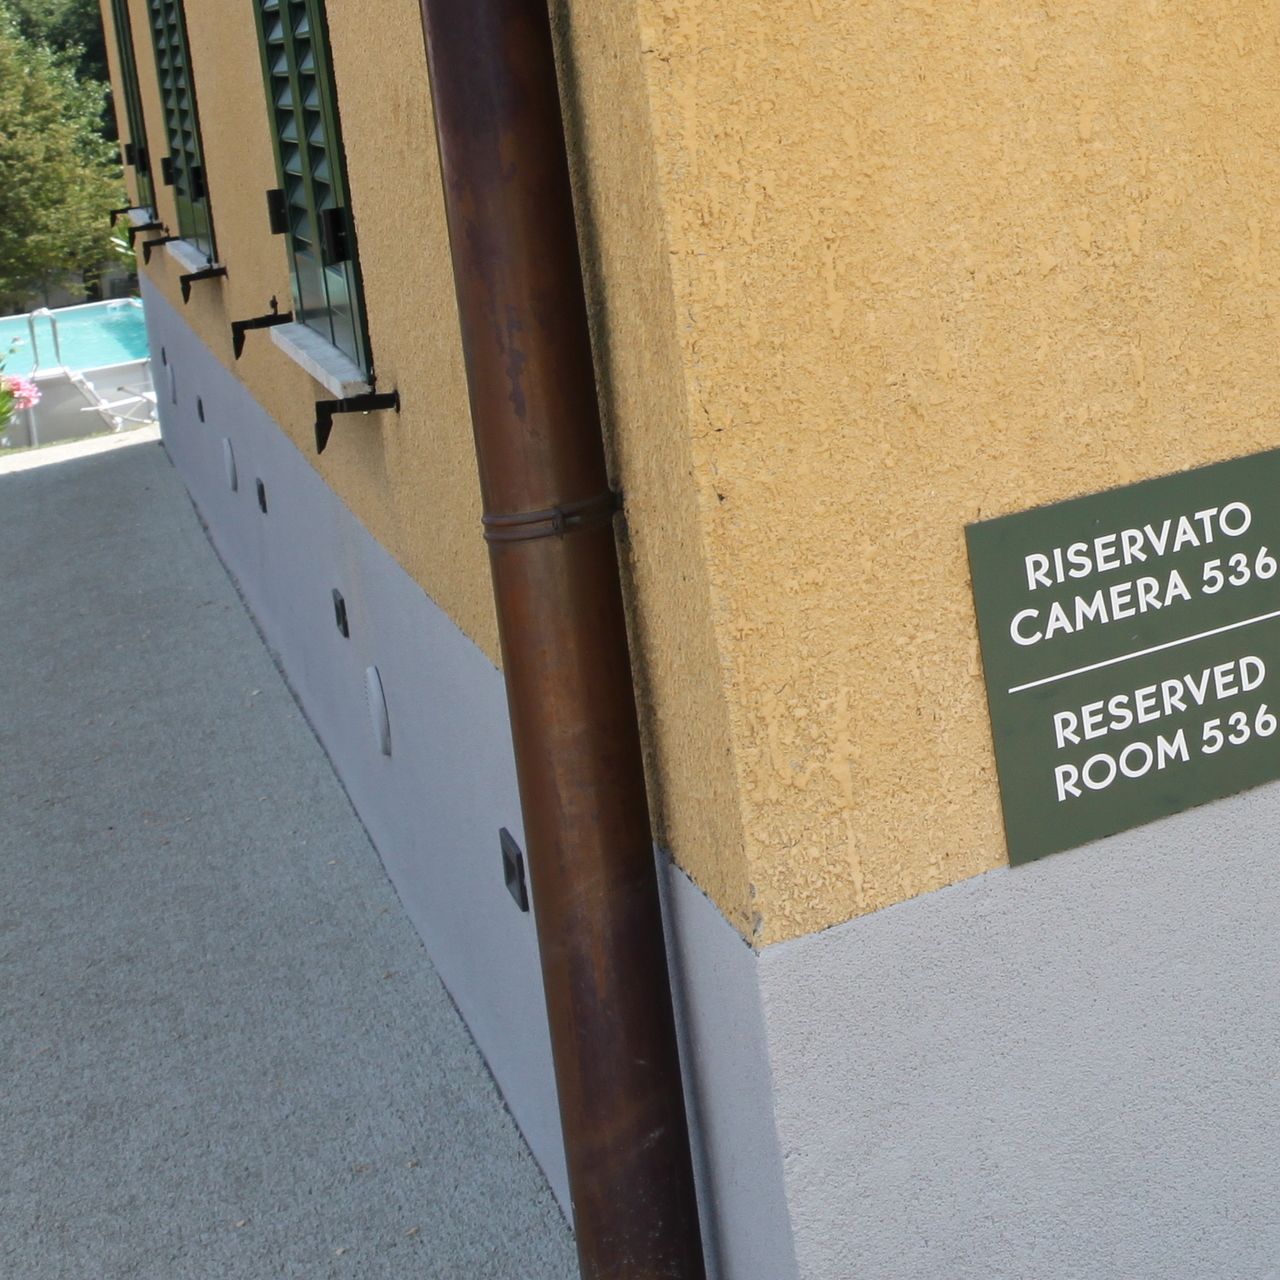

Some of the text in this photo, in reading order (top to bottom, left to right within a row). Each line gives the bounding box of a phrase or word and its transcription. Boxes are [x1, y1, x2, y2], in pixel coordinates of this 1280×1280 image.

[1024, 501, 1252, 591] RISERVATO
[1009, 545, 1278, 646] CAMERA 536
[1053, 655, 1266, 749] RESERVED
[1054, 703, 1278, 802] ROOM 536
